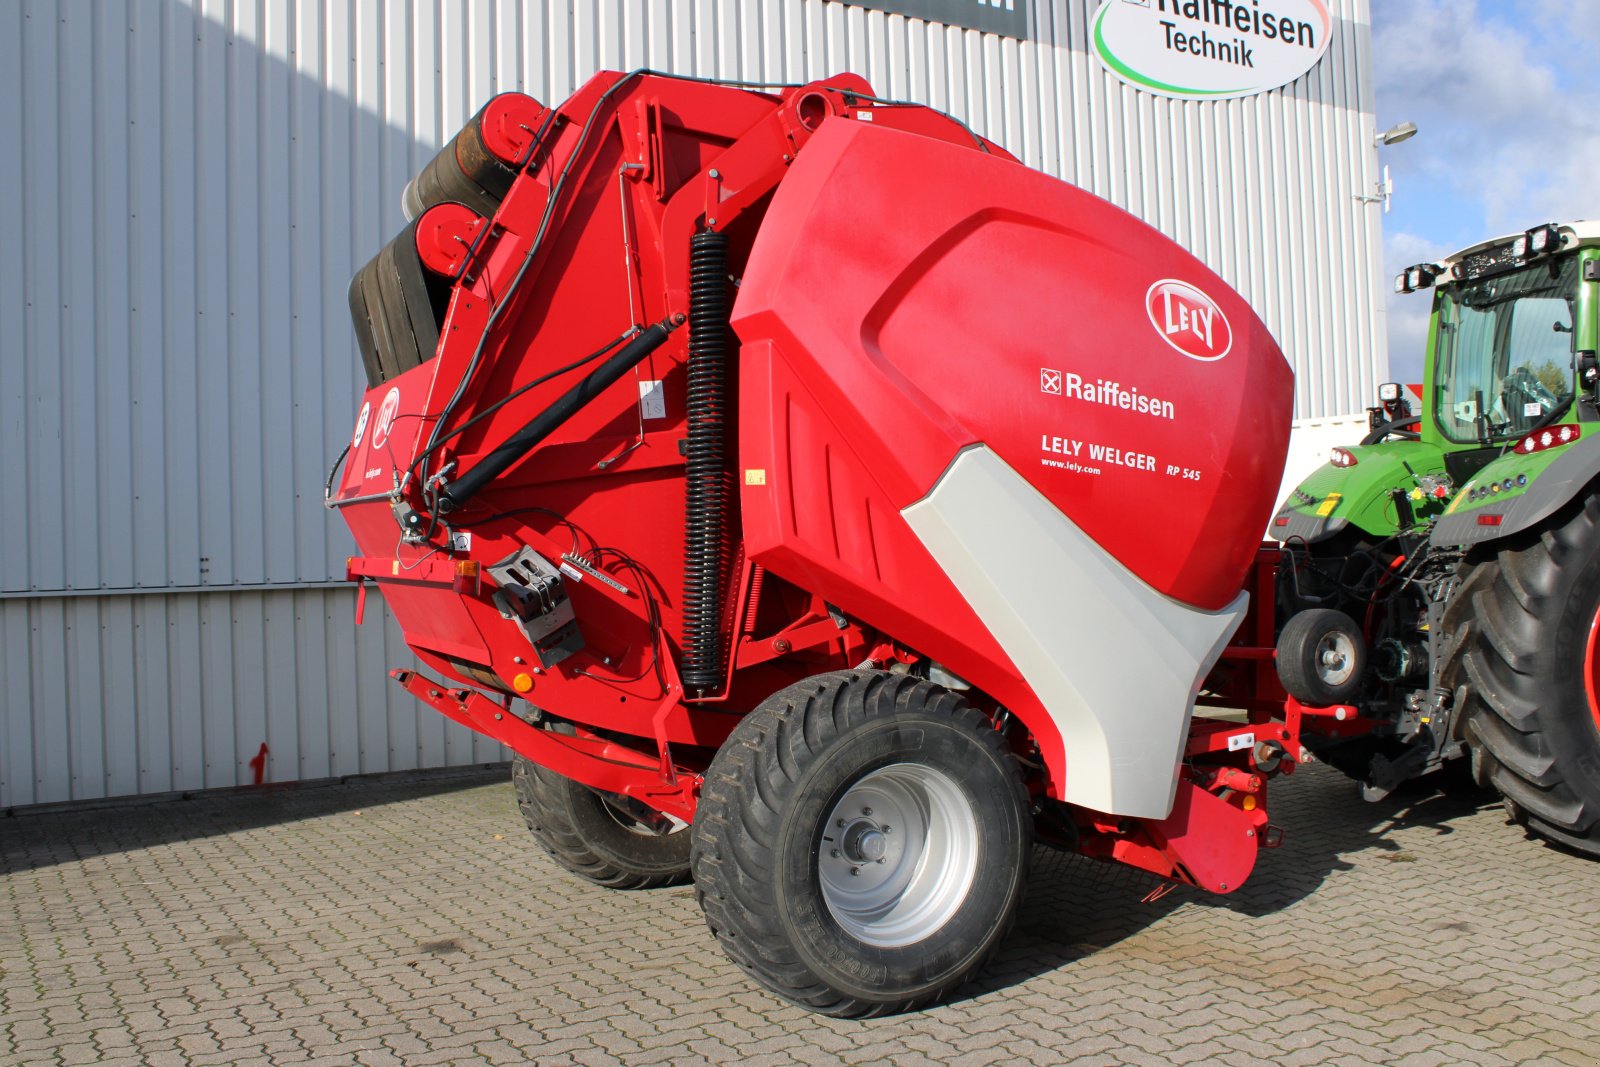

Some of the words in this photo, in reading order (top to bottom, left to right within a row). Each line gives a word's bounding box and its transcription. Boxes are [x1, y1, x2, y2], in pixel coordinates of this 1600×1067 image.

[1160, 21, 1254, 67] Technik
[1163, 288, 1213, 350] LELY
[1066, 373, 1175, 420] Raiffeisen
[1041, 434, 1083, 457] LELY
[1089, 443, 1156, 472] WELGER
[1166, 464, 1180, 477] RP
[1182, 468, 1201, 482] 545
[1041, 458, 1101, 476] www.lely.com
